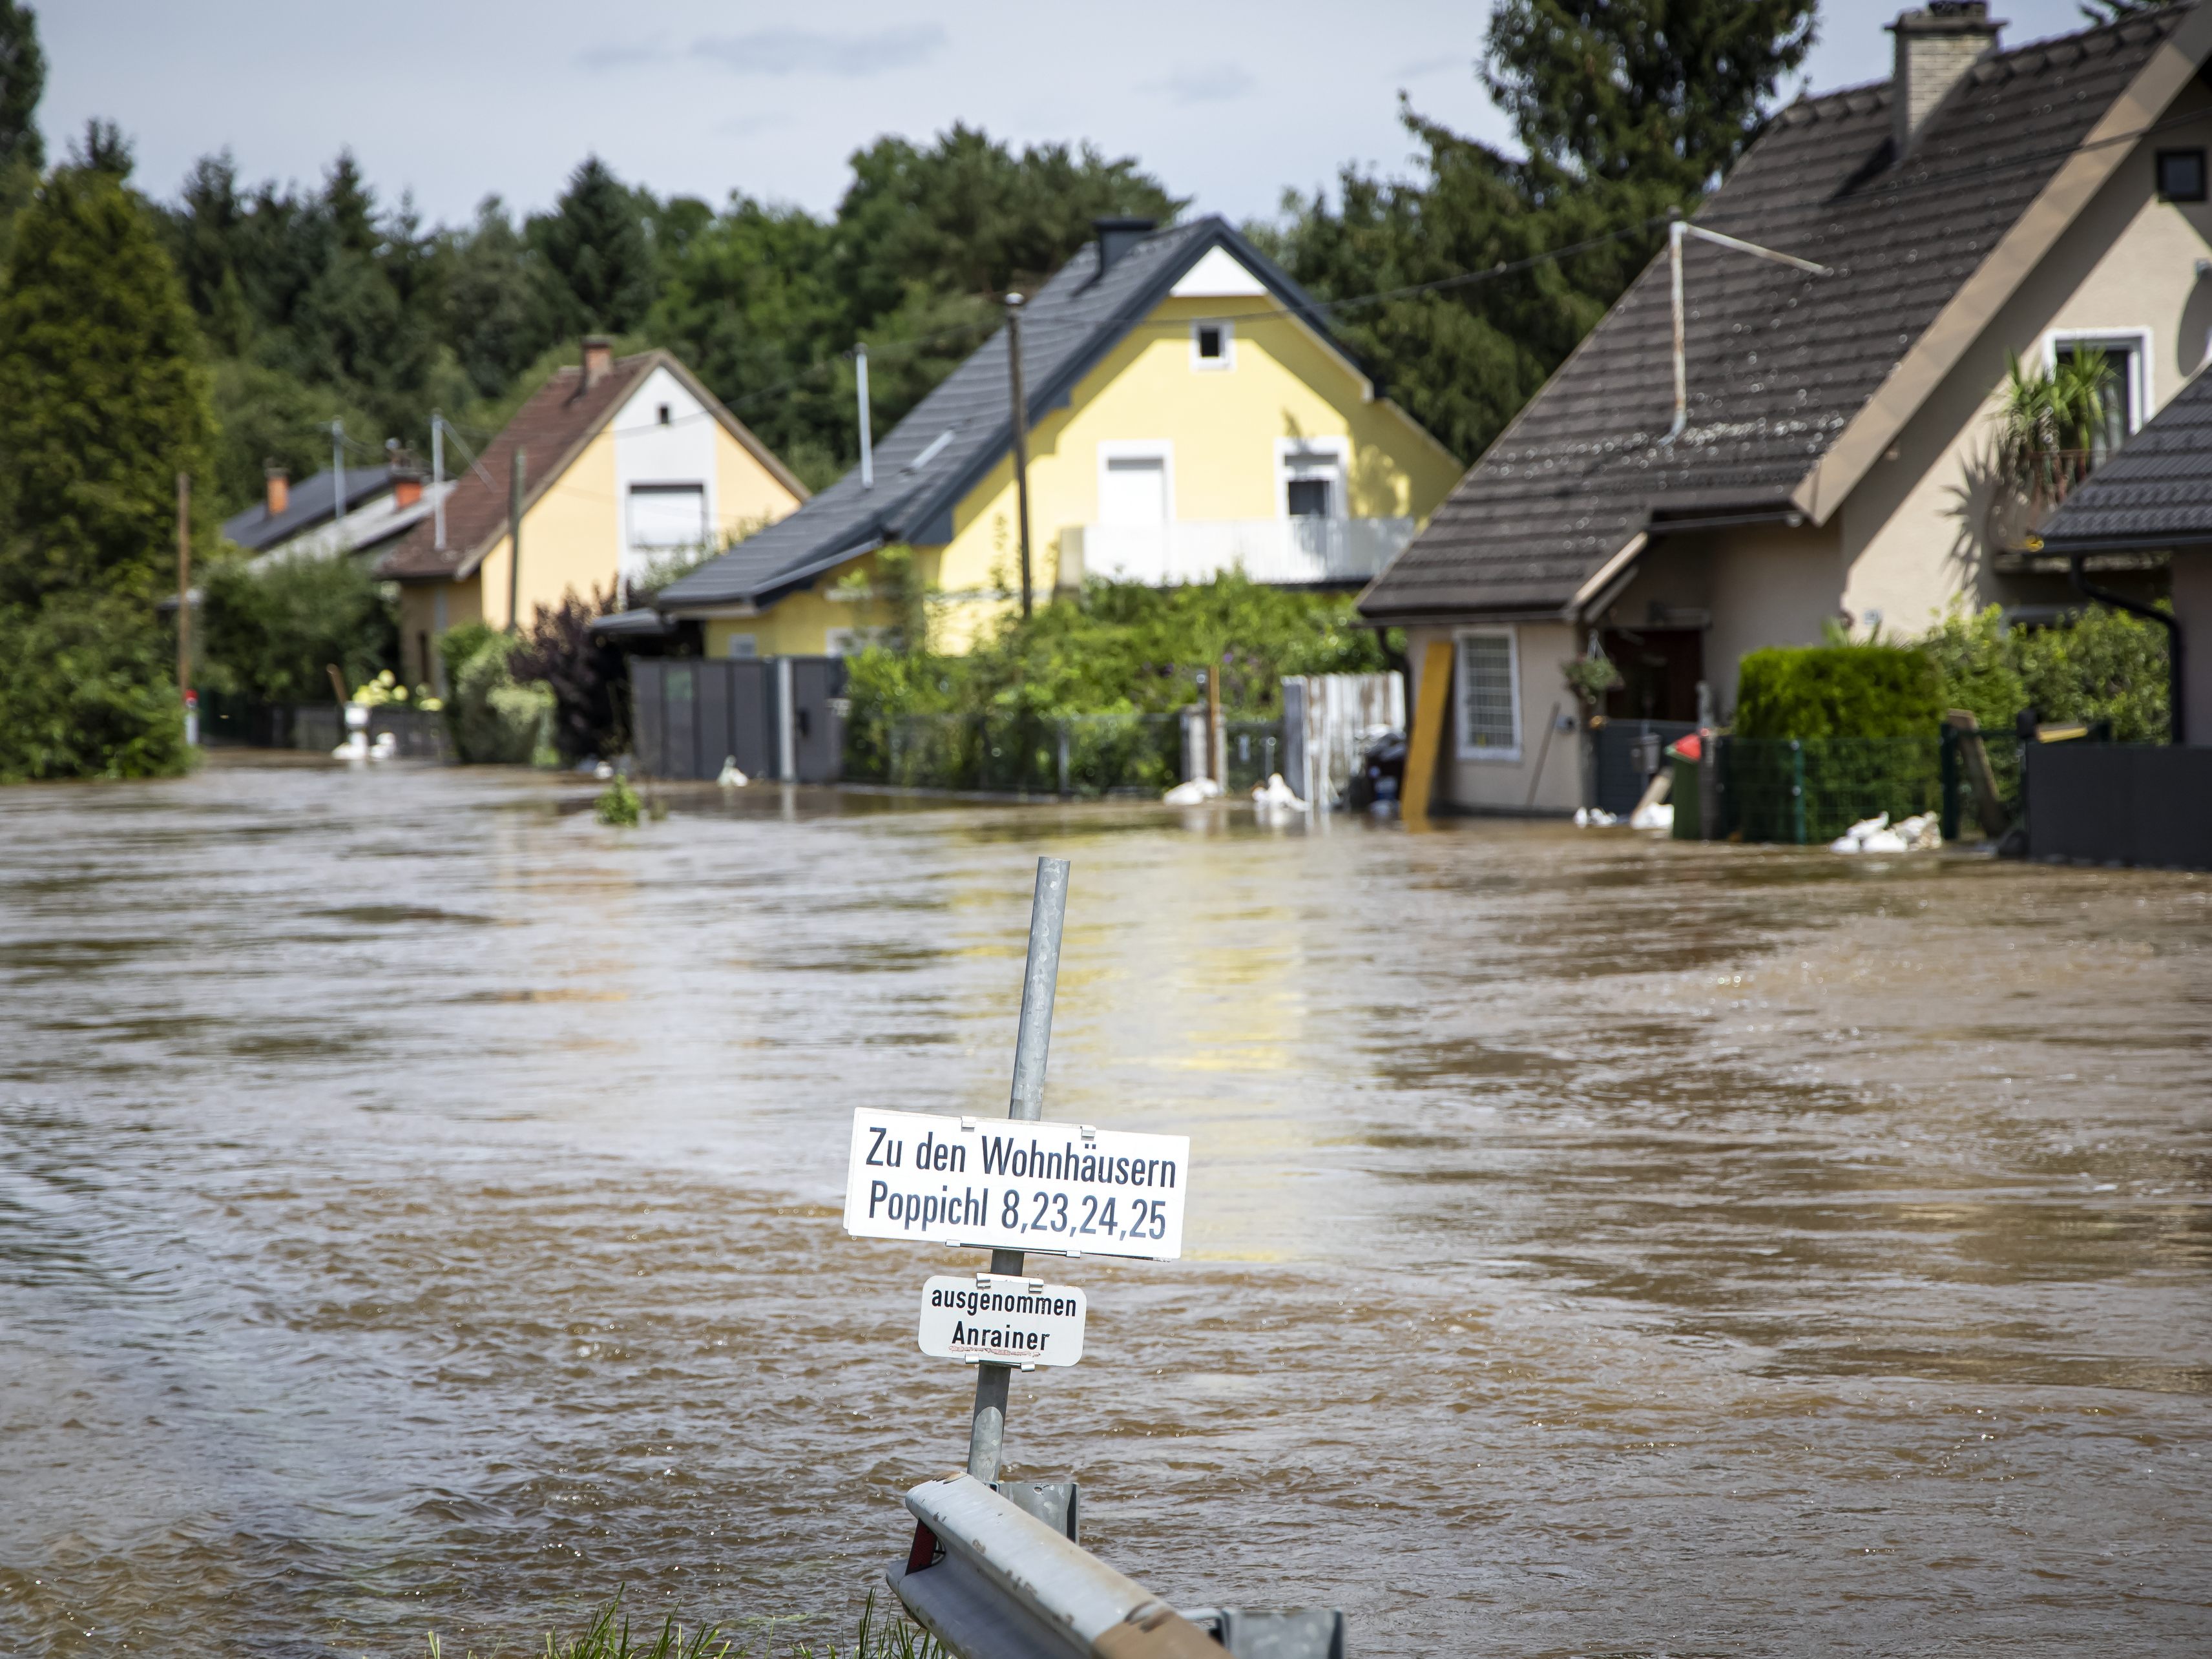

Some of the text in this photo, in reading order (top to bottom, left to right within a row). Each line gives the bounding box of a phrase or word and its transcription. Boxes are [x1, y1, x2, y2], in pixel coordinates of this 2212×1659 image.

[866, 1127, 1176, 1188] Zu den Wohnhäusern
[869, 1180, 1166, 1241] Poppichl 8,23,24,25
[932, 1289, 1076, 1317] ausgenommen
[952, 1320, 1050, 1351] Anrainer
